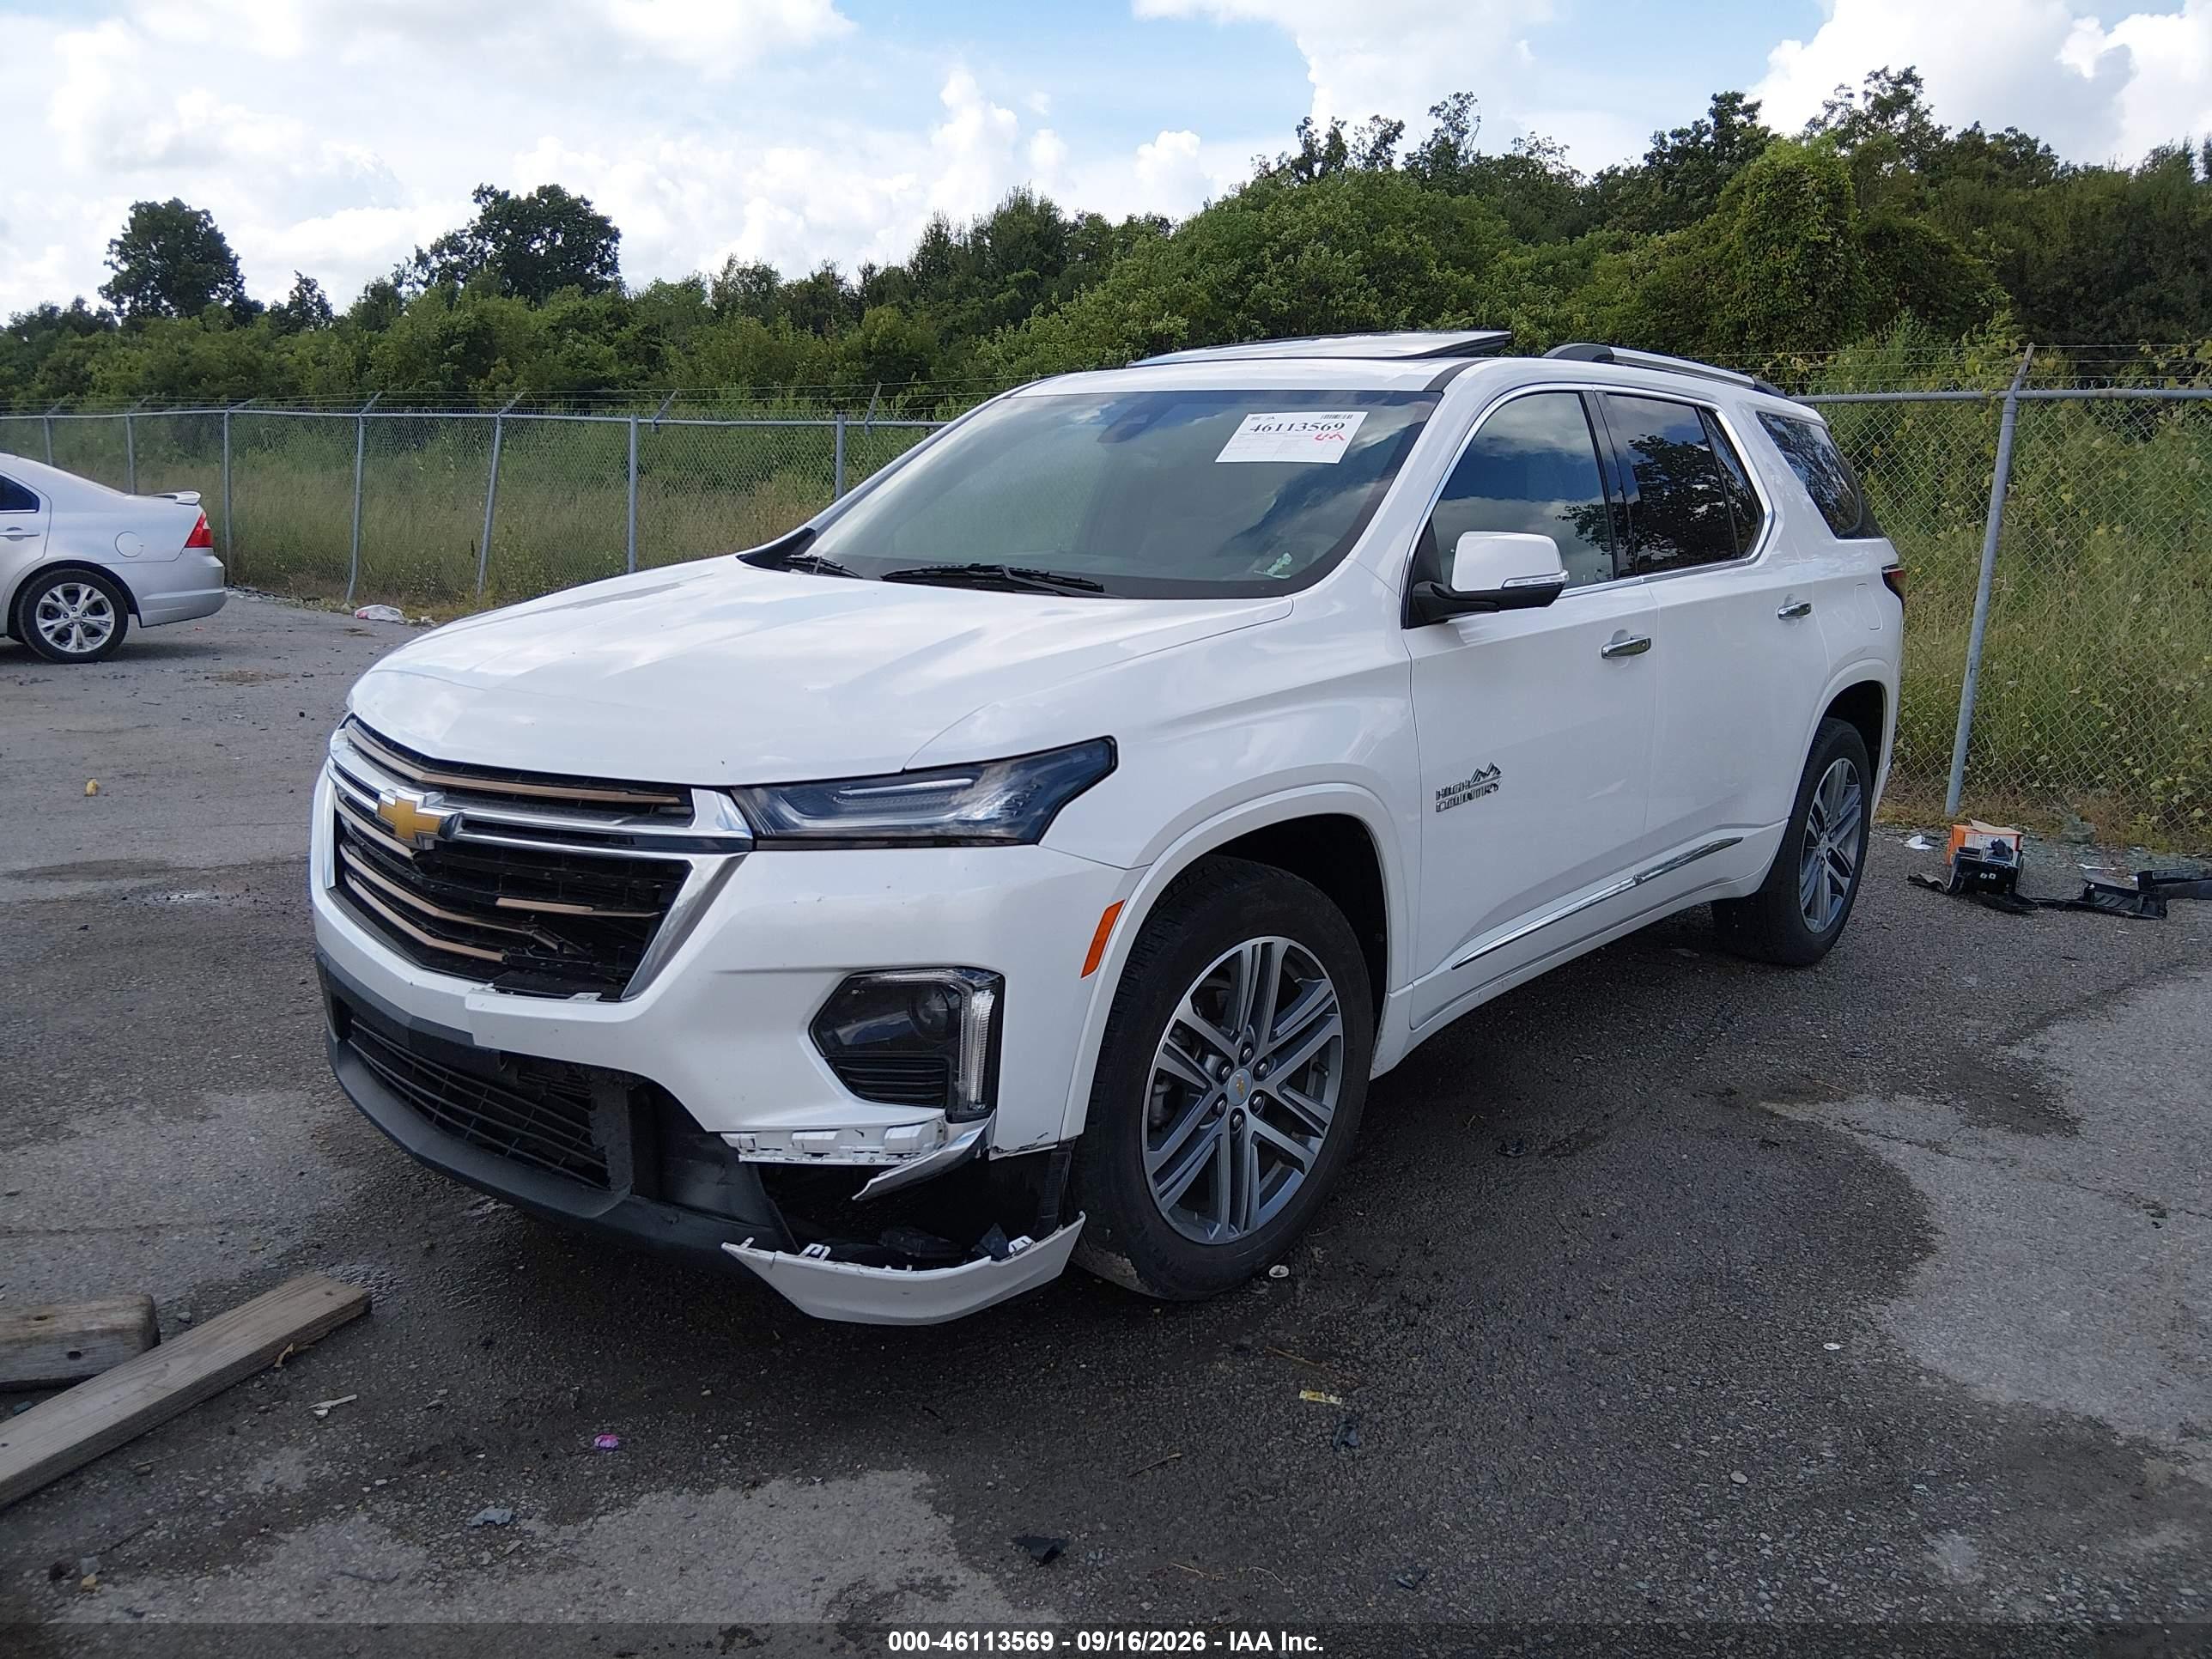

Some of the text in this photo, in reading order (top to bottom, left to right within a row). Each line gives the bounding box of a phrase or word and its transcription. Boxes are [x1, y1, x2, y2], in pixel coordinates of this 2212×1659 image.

[1249, 422, 1346, 433] 46113569
[1435, 780, 1471, 801] HIGH
[1435, 779, 1502, 812] COUNTRY
